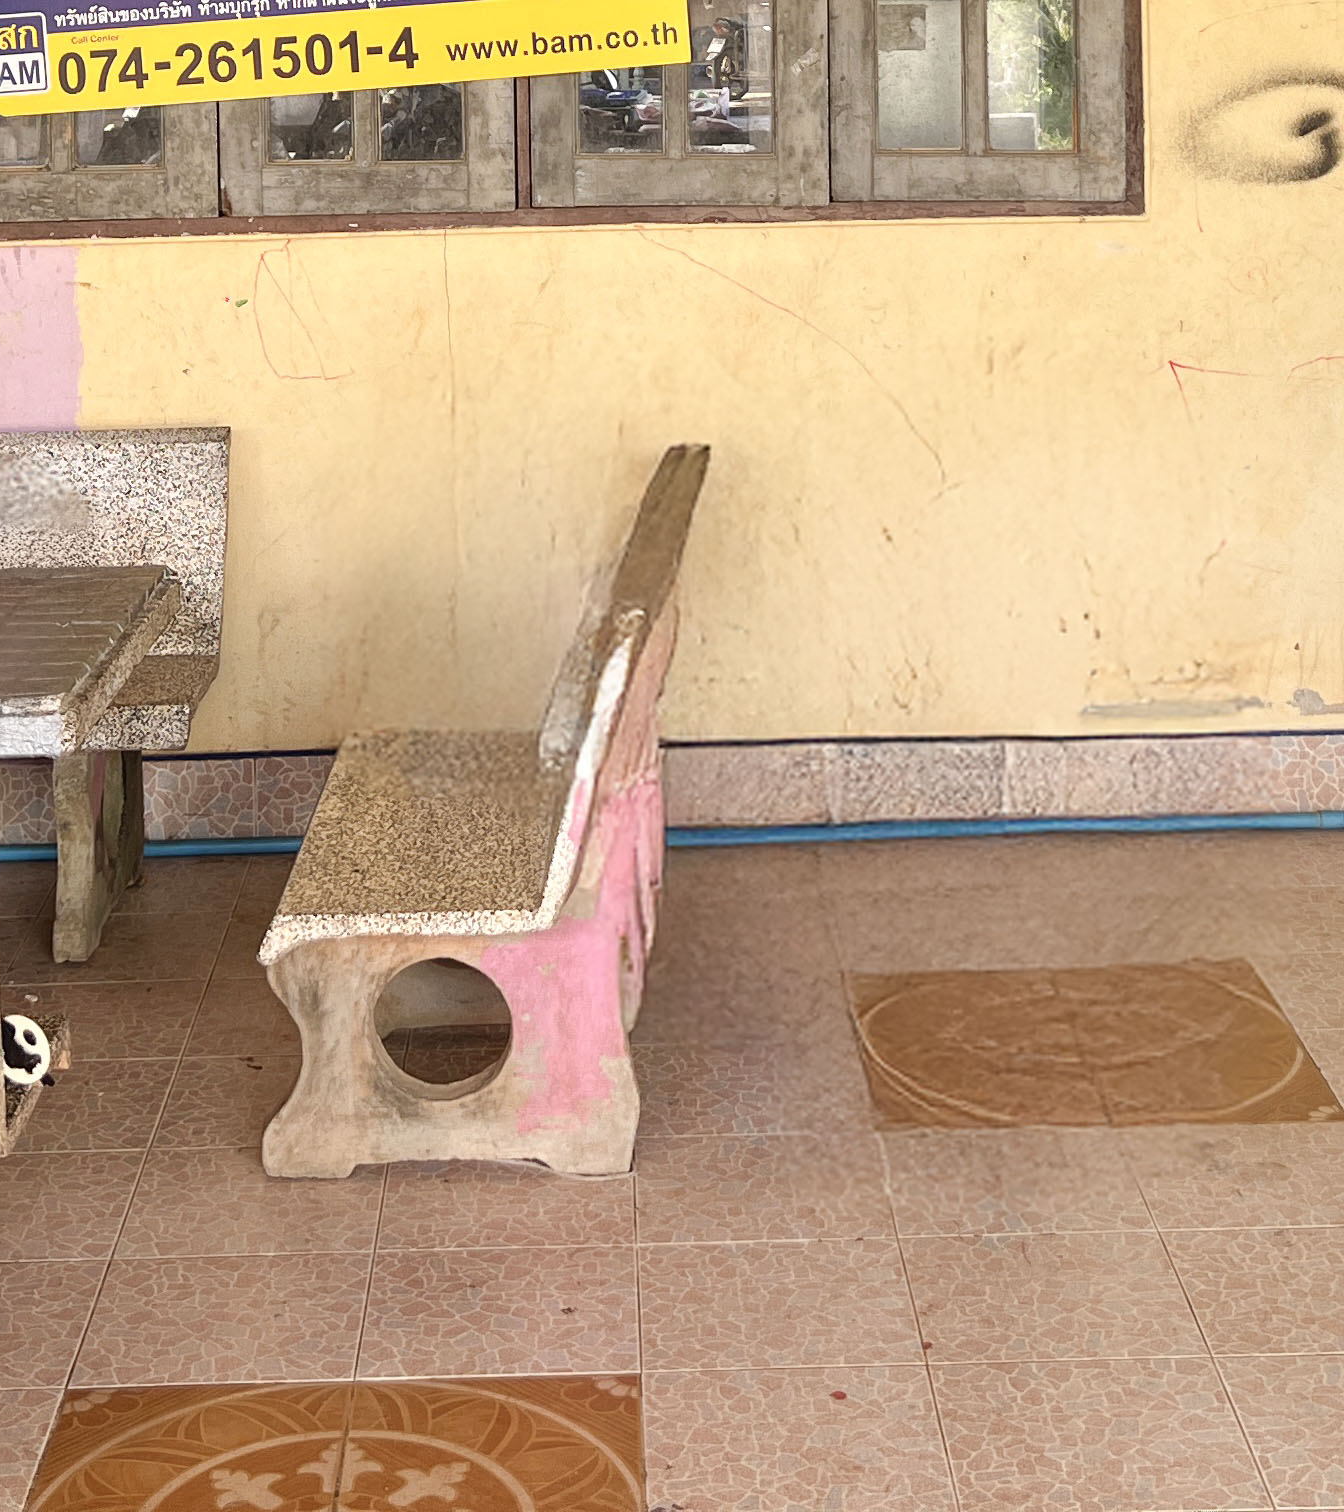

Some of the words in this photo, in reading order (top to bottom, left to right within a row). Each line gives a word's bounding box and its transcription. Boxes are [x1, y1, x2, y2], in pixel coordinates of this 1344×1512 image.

[54, 0, 192, 28] ทรัพย์สินของบริษัท
[58, 26, 419, 95] 074-261501-4
[445, 21, 679, 62] www.bam.co.th
